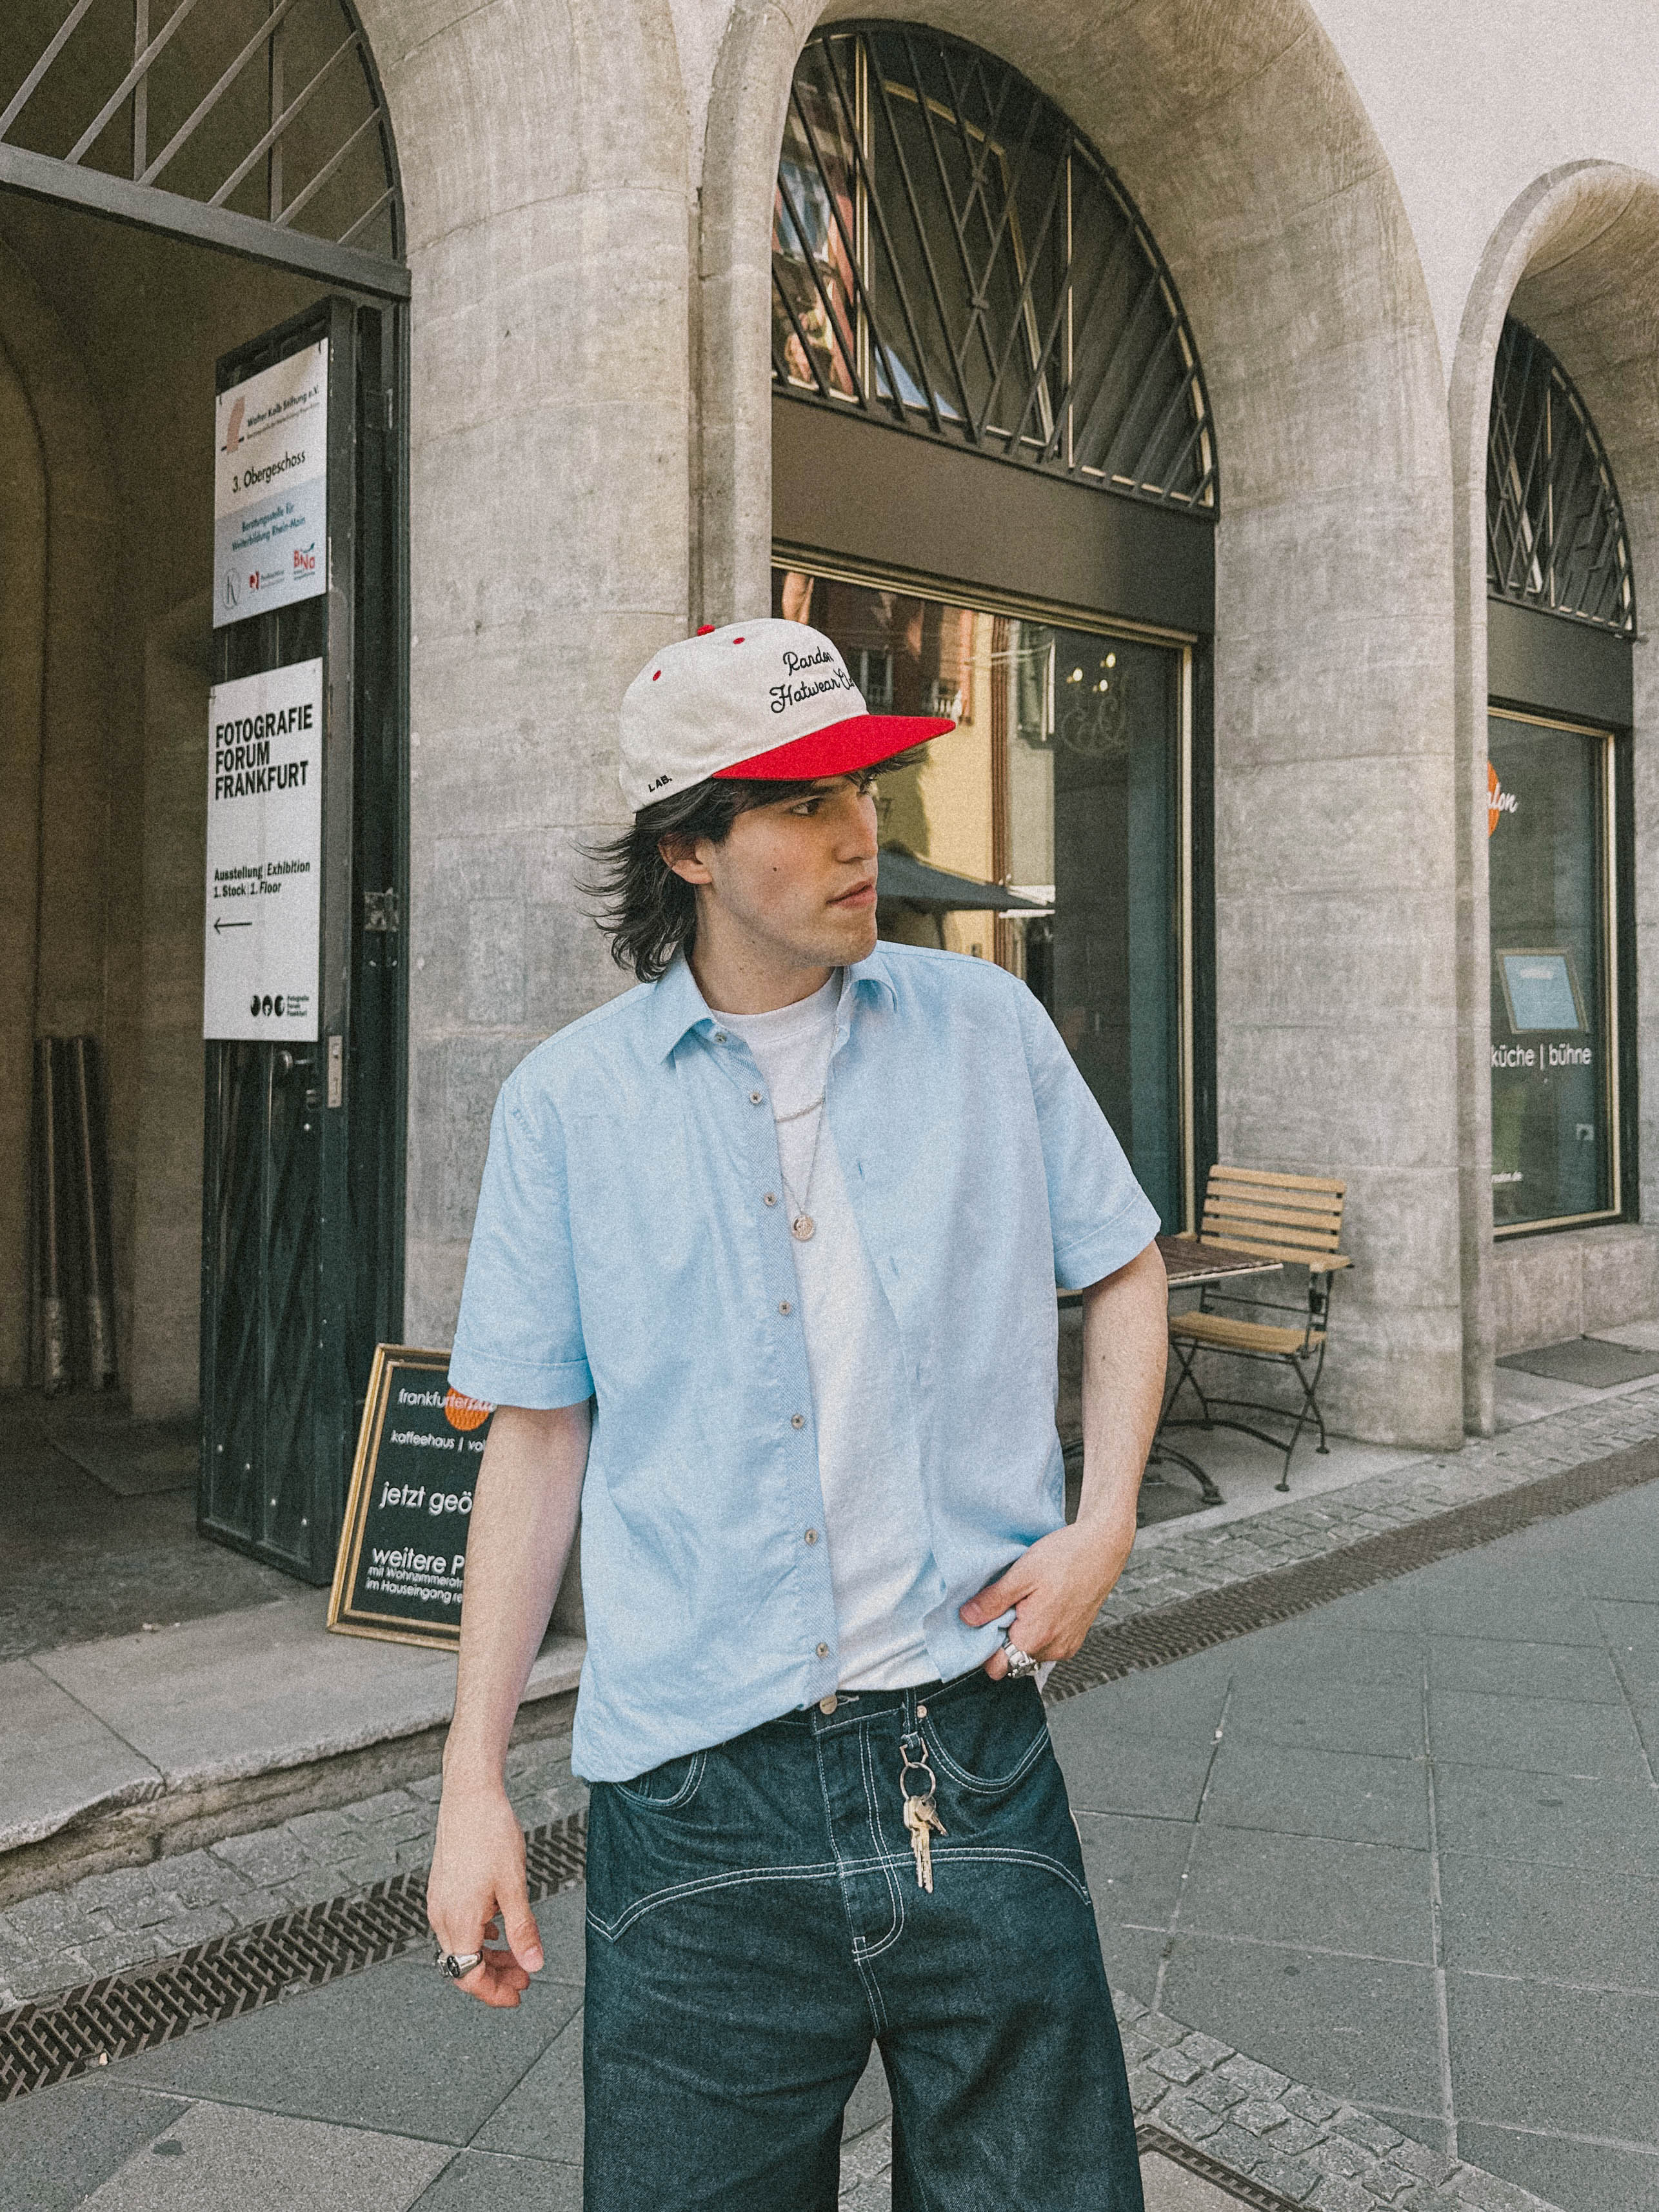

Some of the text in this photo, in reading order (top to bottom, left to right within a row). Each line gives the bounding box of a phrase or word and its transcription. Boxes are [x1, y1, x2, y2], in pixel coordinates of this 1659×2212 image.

[232, 451, 306, 493] 3. Obergeschoss
[769, 678, 840, 714] Hatwear
[215, 704, 313, 749] FOTOGRAFIE
[215, 740, 270, 775] FORUM
[215, 760, 308, 800] FRANKFURT
[648, 775, 673, 793] LAB.
[214, 860, 310, 881] Ausstellung Exhibition
[214, 881, 282, 898] 1. Stock 1. Floor
[1491, 1044, 1535, 1067] küche
[1549, 1043, 1592, 1066] bühne
[390, 1429, 455, 1450] kaffeehaus
[378, 1481, 473, 1516] jetzt geö
[368, 1566, 384, 1577] mit
[372, 1546, 446, 1574] weitere
[365, 1577, 379, 1590] im
[381, 1579, 452, 1605] Hauseingang
